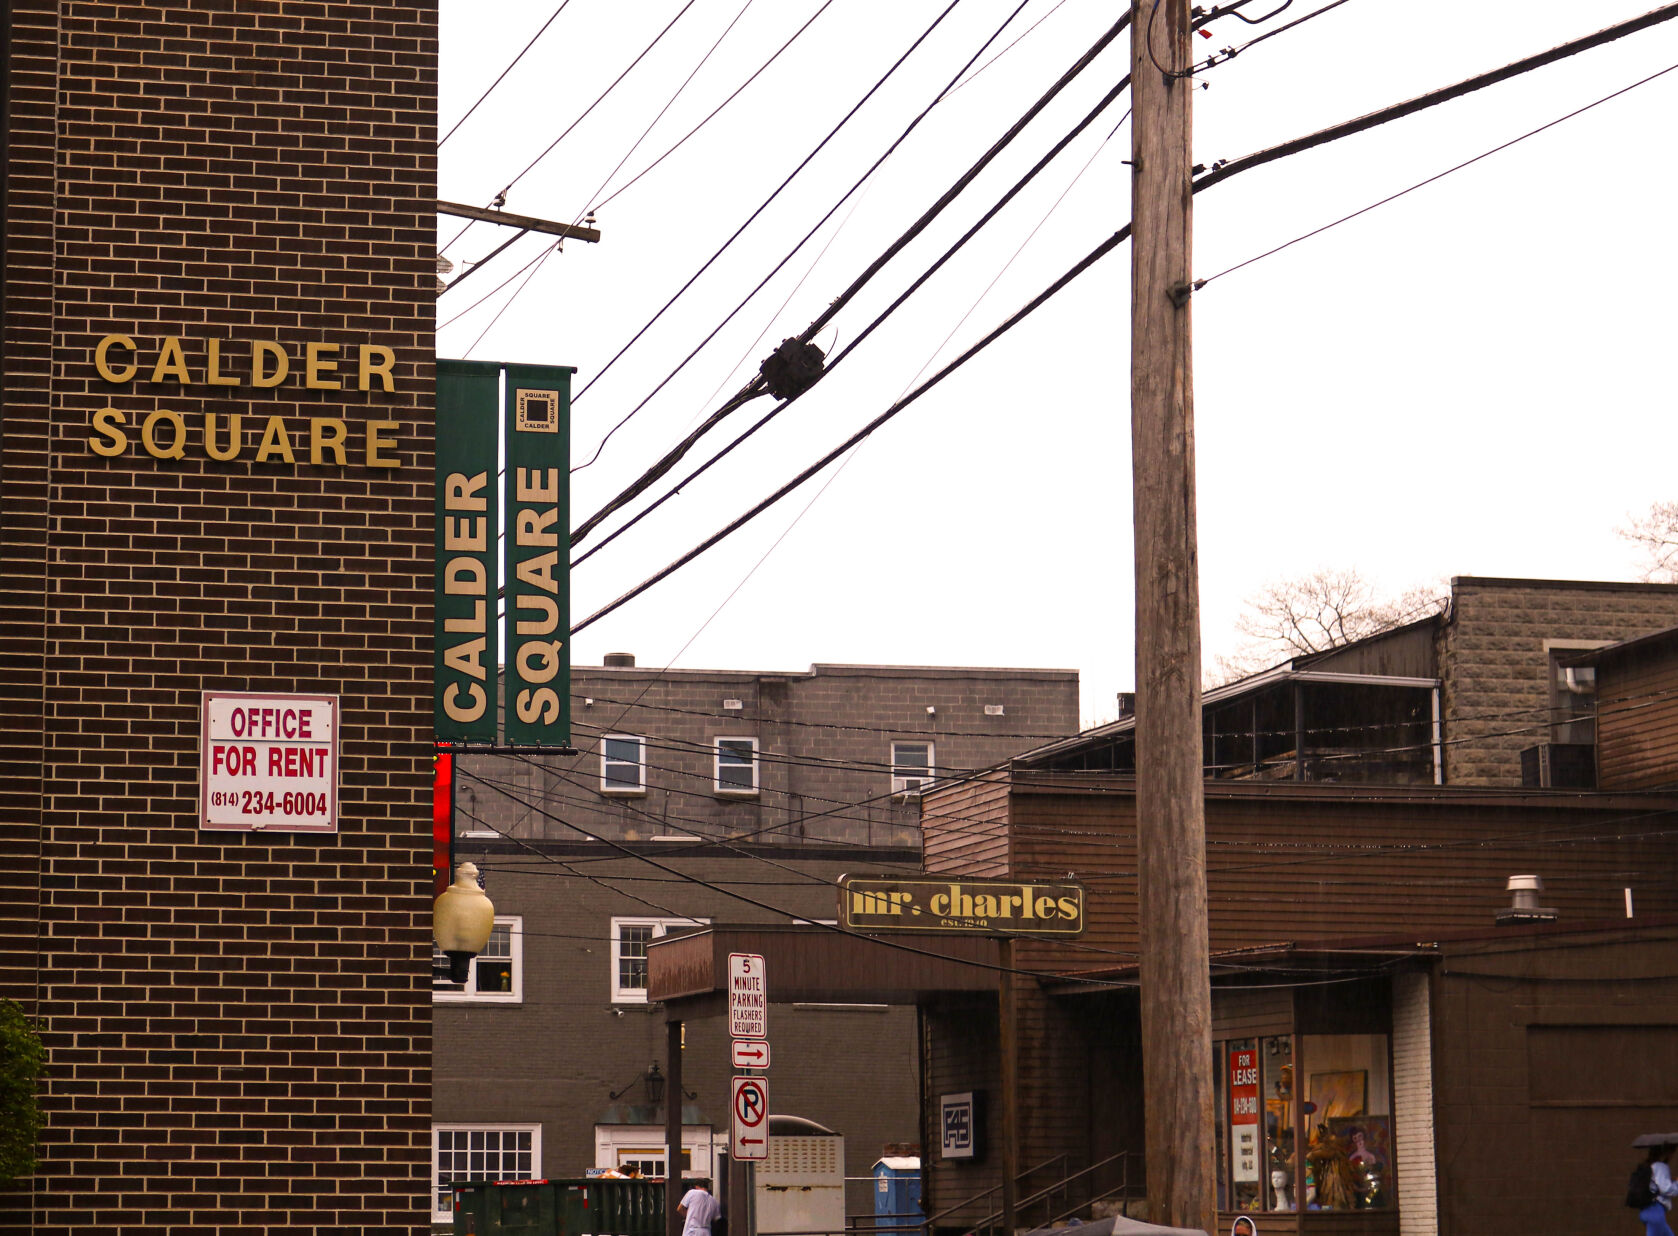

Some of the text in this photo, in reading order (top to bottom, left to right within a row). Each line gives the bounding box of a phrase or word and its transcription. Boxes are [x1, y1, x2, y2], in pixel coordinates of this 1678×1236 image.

[95, 333, 396, 393] CALDER
[88, 408, 402, 468] SQUARE
[442, 470, 488, 724] CALDER
[516, 466, 563, 726] SQUARE
[231, 707, 312, 738] OFFICE
[213, 745, 328, 778] FOR RENT
[211, 790, 327, 816] (814) 234-6004
[851, 884, 1079, 920] mr. charles
[743, 959, 751, 974] 5
[734, 976, 760, 991] MINUTE
[732, 993, 763, 1008] PARKING
[733, 1009, 763, 1021] FLASHERS
[734, 1021, 762, 1034] REQUIRED
[1238, 1055, 1250, 1067] FOR
[1232, 1068, 1257, 1086] LEASE
